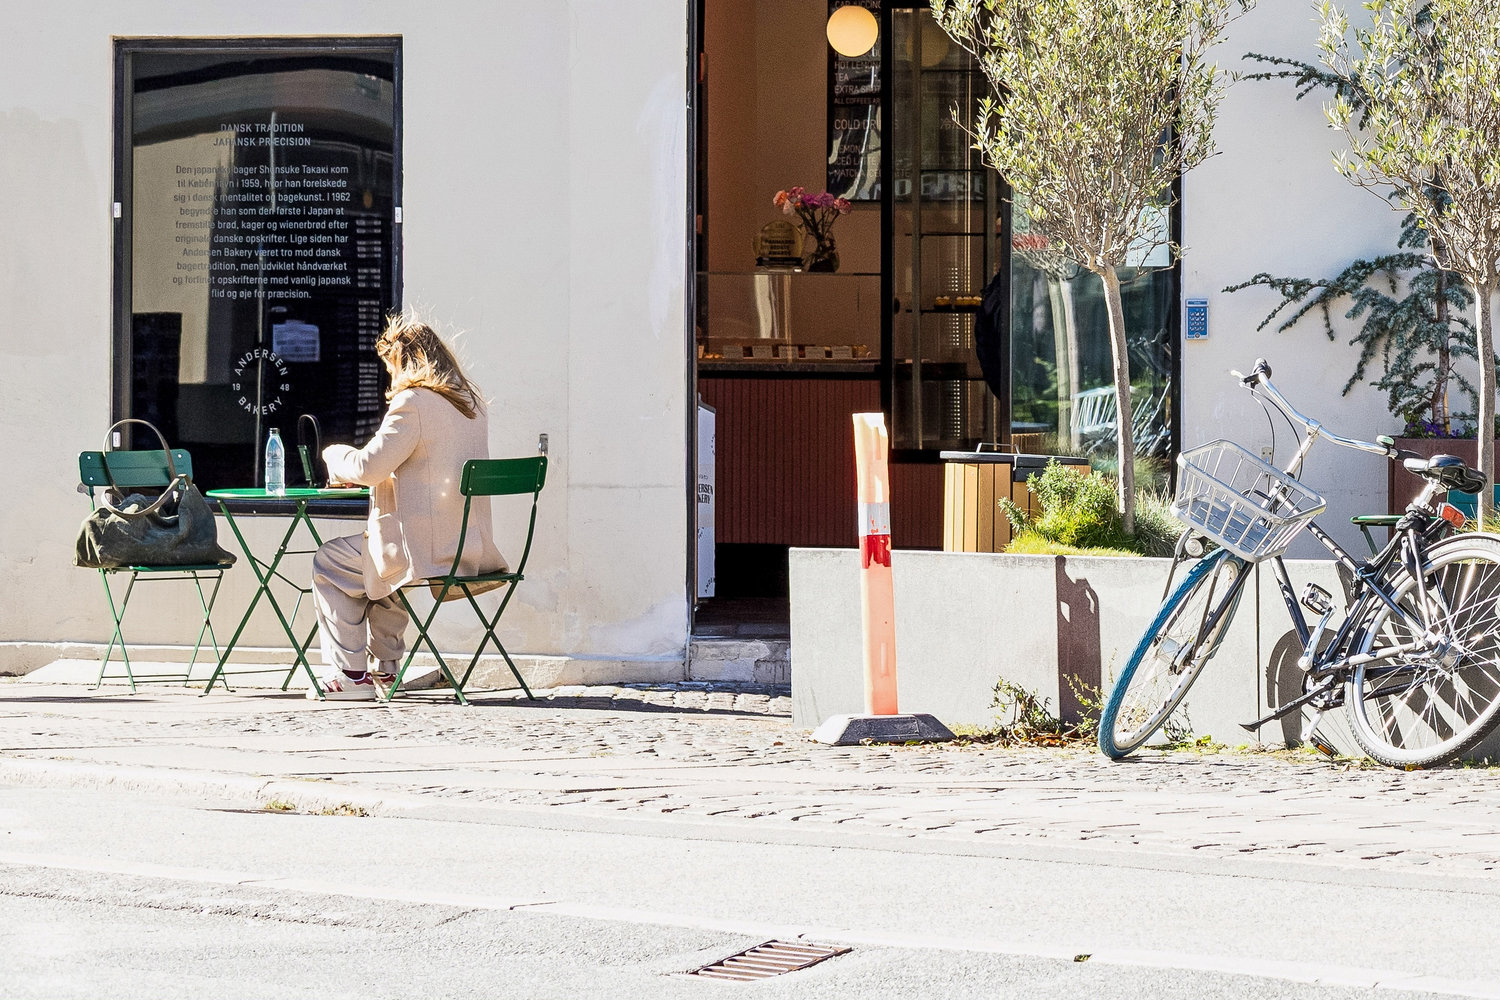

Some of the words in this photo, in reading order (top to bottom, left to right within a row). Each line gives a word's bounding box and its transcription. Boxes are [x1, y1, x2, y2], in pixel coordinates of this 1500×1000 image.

[220, 123, 253, 133] DANSK
[254, 123, 304, 133] TRADITION
[834, 118, 861, 130] COLD
[175, 165, 192, 174] Den
[233, 165, 258, 176] bager
[284, 179, 301, 188] han
[302, 178, 347, 188] forelskede
[278, 192, 325, 204] bagekunst.
[331, 192, 351, 202] 1962
[220, 207, 237, 216] han
[238, 208, 257, 216] som
[258, 206, 275, 216] den
[276, 206, 301, 216] første
[307, 206, 334, 217] Japan
[335, 206, 345, 216] at
[241, 220, 265, 231] kager
[266, 221, 278, 231] og
[279, 220, 326, 230] wienerbrød
[328, 220, 349, 229] efter
[213, 234, 244, 243] danske
[245, 233, 288, 245] opskrifter.
[289, 233, 308, 245] Lige
[309, 233, 333, 243] siden
[334, 233, 349, 243] har
[223, 247, 253, 259] Bakery
[280, 249, 293, 257] tro
[294, 247, 314, 257] mod
[315, 247, 341, 257] dansk
[240, 262, 259, 271] men
[261, 261, 295, 271] udviklet
[296, 260, 348, 271] håndværket
[217, 275, 269, 286] opskrifterne
[270, 275, 289, 285] med
[290, 275, 316, 287] vanlig
[317, 275, 352, 287] japansk
[211, 288, 225, 298] flid
[226, 289, 238, 299] og
[239, 289, 252, 299] øje
[254, 288, 266, 298] for
[267, 288, 312, 300] præcision.
[234, 348, 288, 377] ANDERSEN
[232, 383, 241, 391] 19
[238, 395, 283, 415] BAKERY
